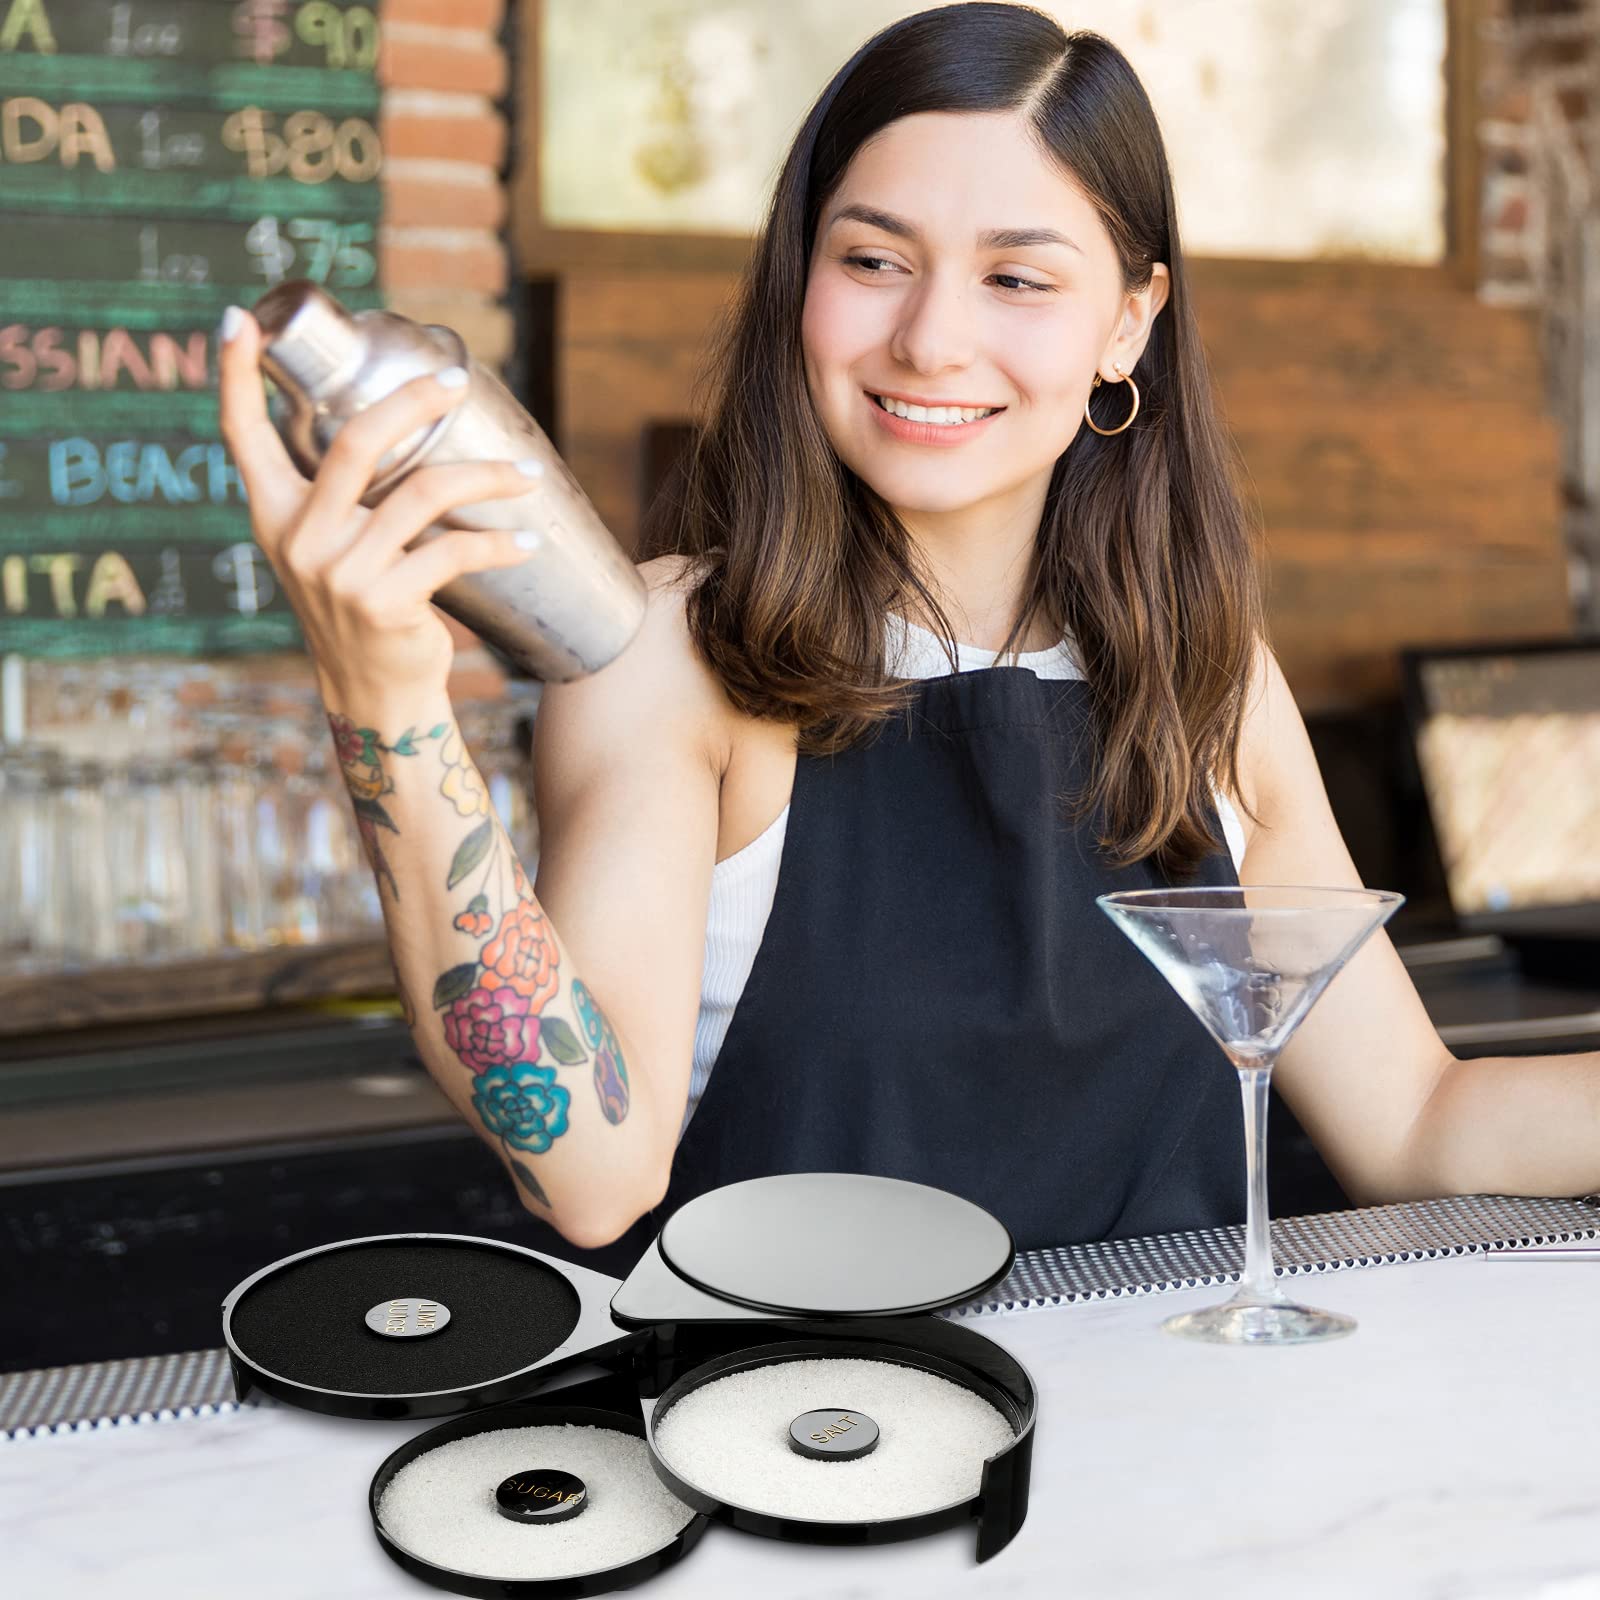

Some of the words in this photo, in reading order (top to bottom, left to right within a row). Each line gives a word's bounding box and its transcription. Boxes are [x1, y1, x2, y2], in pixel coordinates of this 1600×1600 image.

[221, 105, 382, 184] $80
[245, 215, 377, 287] $75
[0, 324, 207, 391] SSIAN
[48, 437, 248, 506] BEACH
[3, 551, 146, 619] ITA
[385, 1300, 409, 1333] JUICE
[416, 1303, 438, 1330] LIME
[810, 1415, 858, 1443] SALT
[501, 1479, 582, 1505] SUGAR
